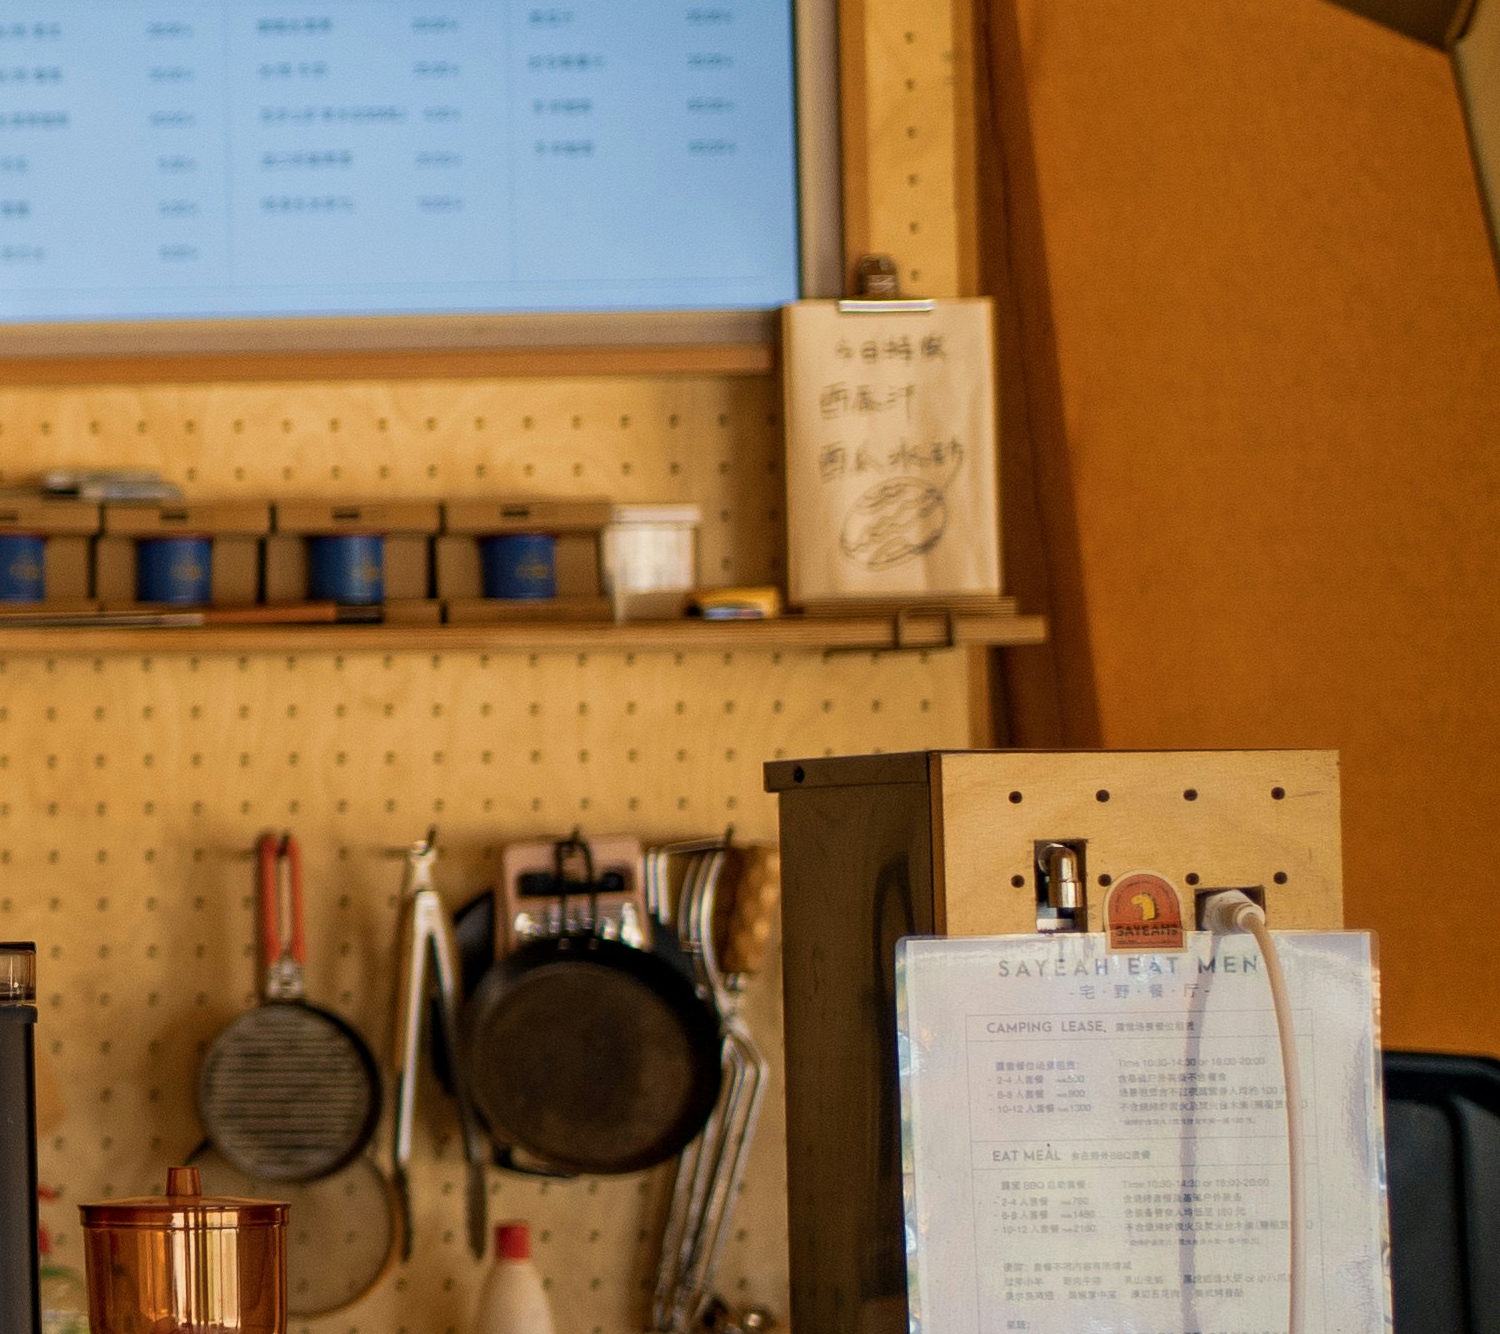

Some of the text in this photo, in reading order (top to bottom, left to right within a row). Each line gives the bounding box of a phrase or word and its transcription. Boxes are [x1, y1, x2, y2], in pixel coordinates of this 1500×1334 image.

[999, 955, 1259, 977] SAYEAH EAT MEN
[987, 1020, 1103, 1034] CAMPING LEASE
[992, 1150, 1061, 1162] EAT MEAL
